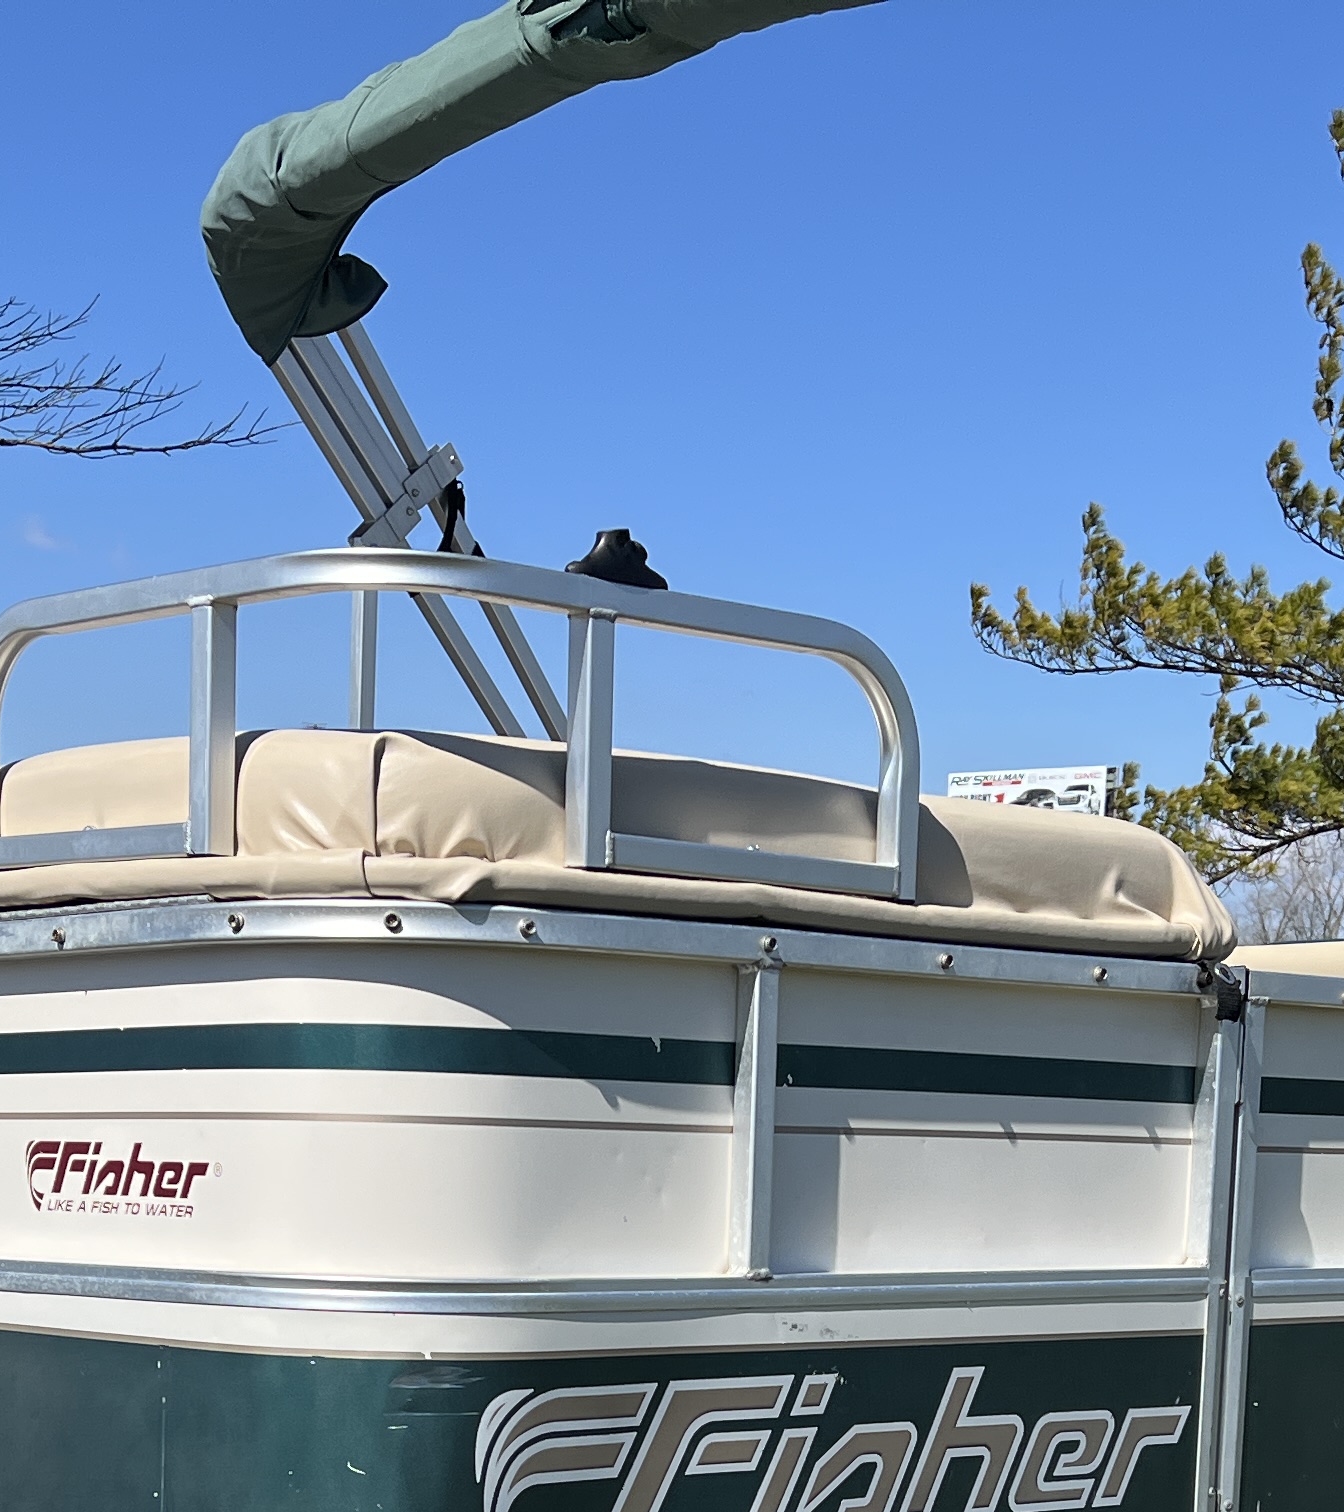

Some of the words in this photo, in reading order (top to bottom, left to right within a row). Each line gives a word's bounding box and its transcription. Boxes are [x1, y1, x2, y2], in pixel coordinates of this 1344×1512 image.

[50, 1141, 210, 1199] Fisher
[46, 1198, 74, 1212] LIKE
[76, 1200, 86, 1212] A
[90, 1201, 120, 1214] FISH
[124, 1202, 141, 1215] TO
[145, 1203, 194, 1218] WATER
